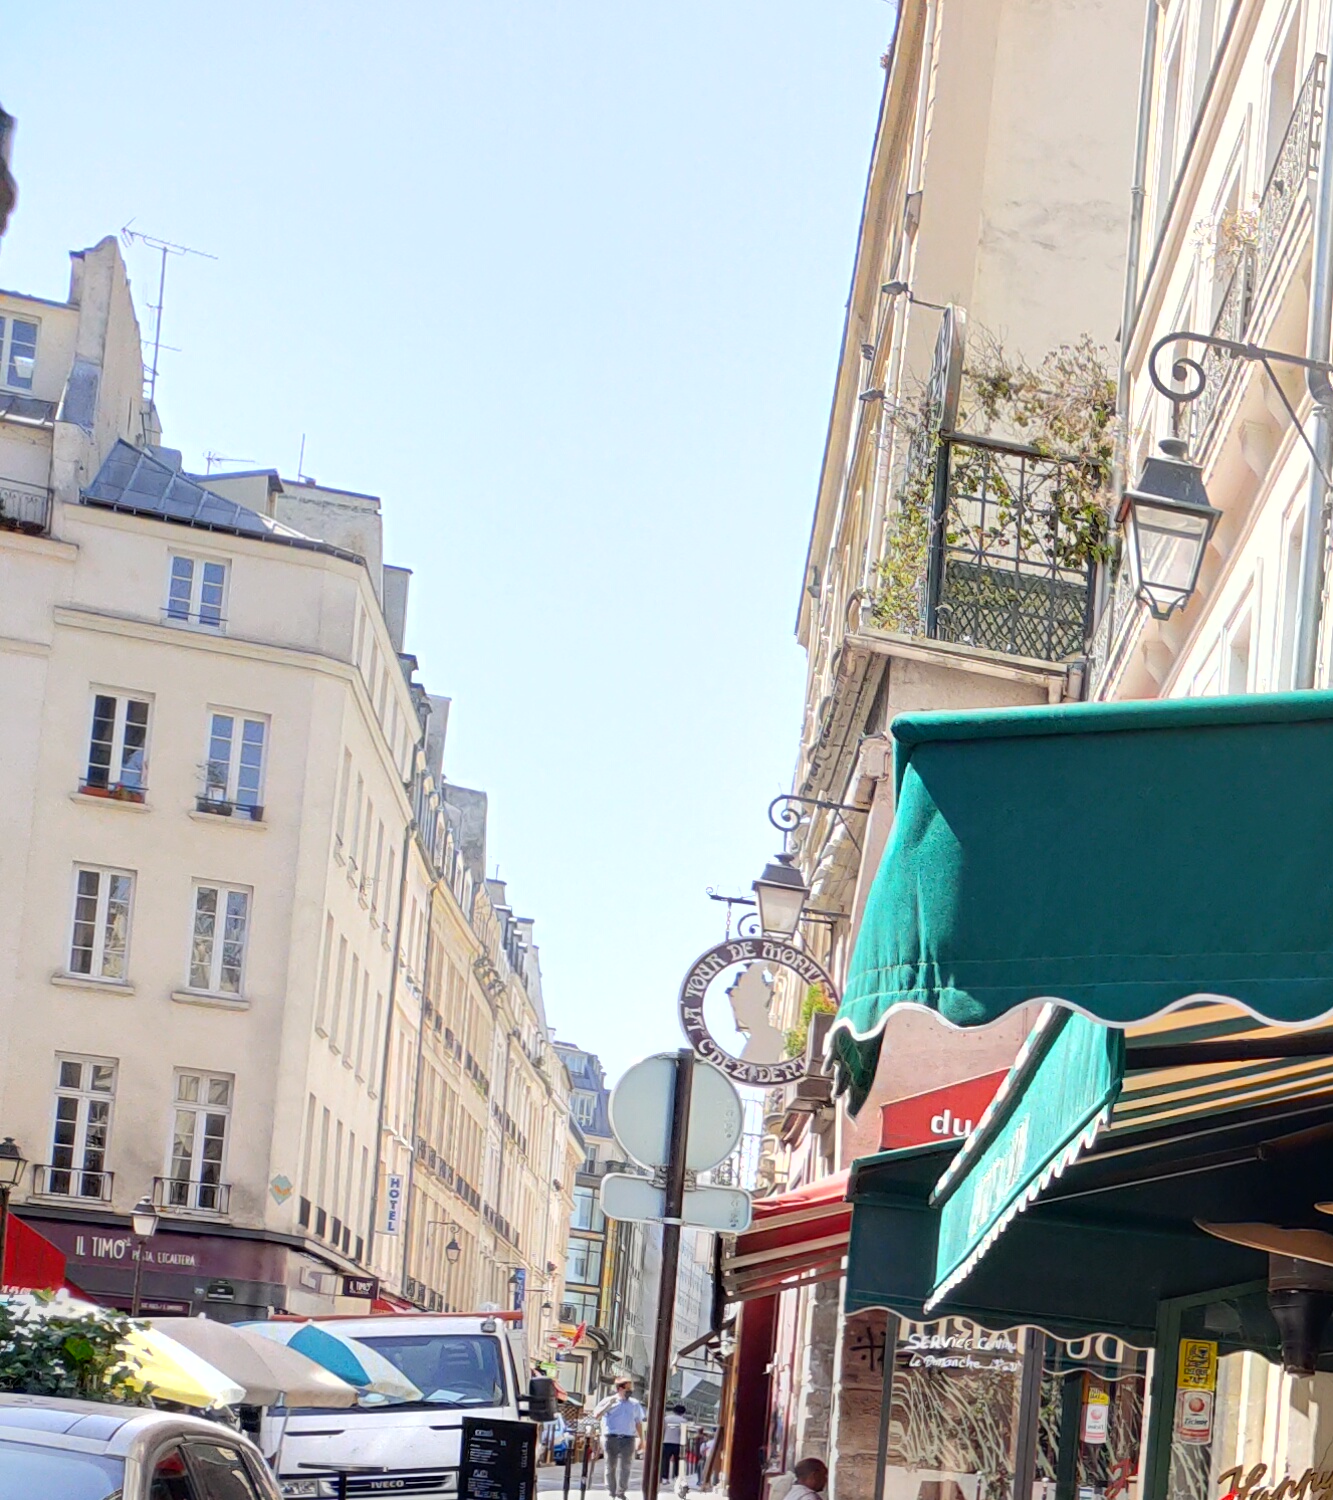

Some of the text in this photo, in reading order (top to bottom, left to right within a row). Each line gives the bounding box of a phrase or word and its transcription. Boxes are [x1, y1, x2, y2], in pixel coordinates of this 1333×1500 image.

[685, 953, 729, 999] TOUR
[726, 941, 757, 962] DE
[930, 1109, 973, 1137] du
[386, 1177, 400, 1232] HOTEL
[75, 1235, 87, 1256] IL
[92, 1236, 125, 1260] TIMO
[370, 1480, 405, 1489] IVECO
